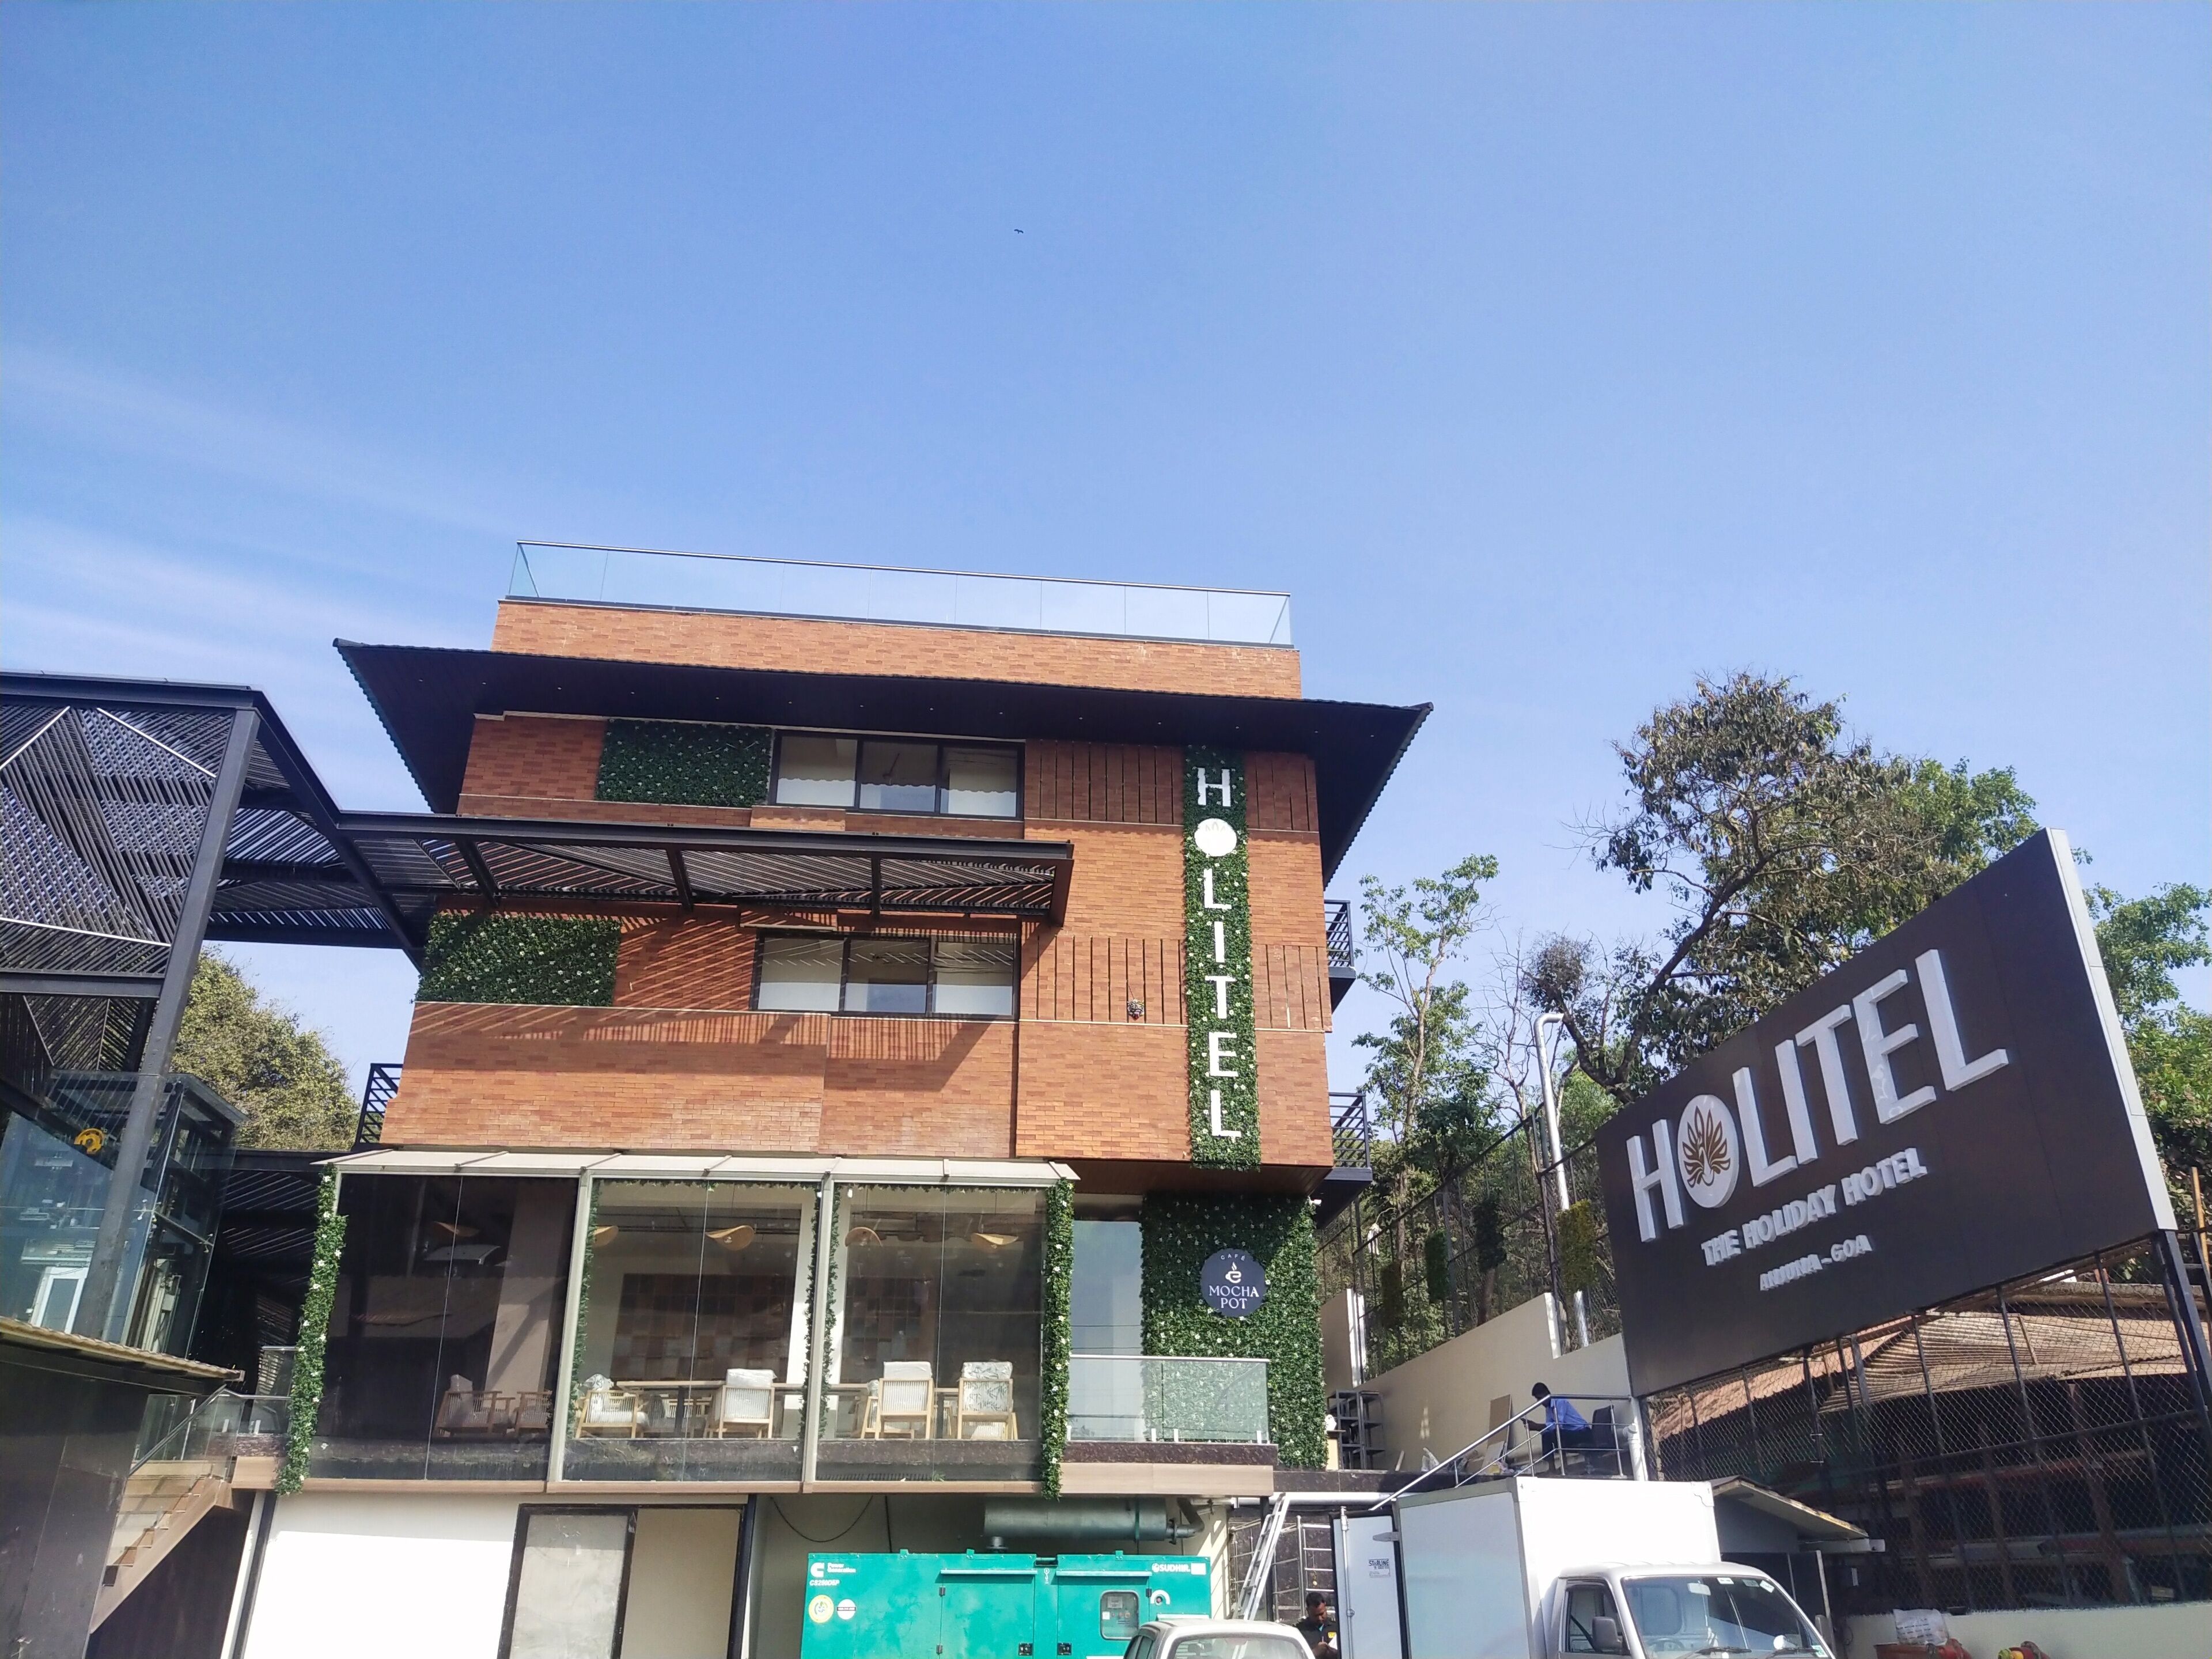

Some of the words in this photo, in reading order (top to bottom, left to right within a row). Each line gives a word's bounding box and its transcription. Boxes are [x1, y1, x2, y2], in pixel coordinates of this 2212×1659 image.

[1626, 949, 2009, 1243] HOLITEL
[1701, 1229, 1741, 1266] THE
[1741, 1184, 1836, 1249] HOLIDAY
[1841, 1147, 1928, 1206] HOTEL
[1209, 1285, 1260, 1297] MOCHA
[1221, 1297, 1248, 1309] POT
